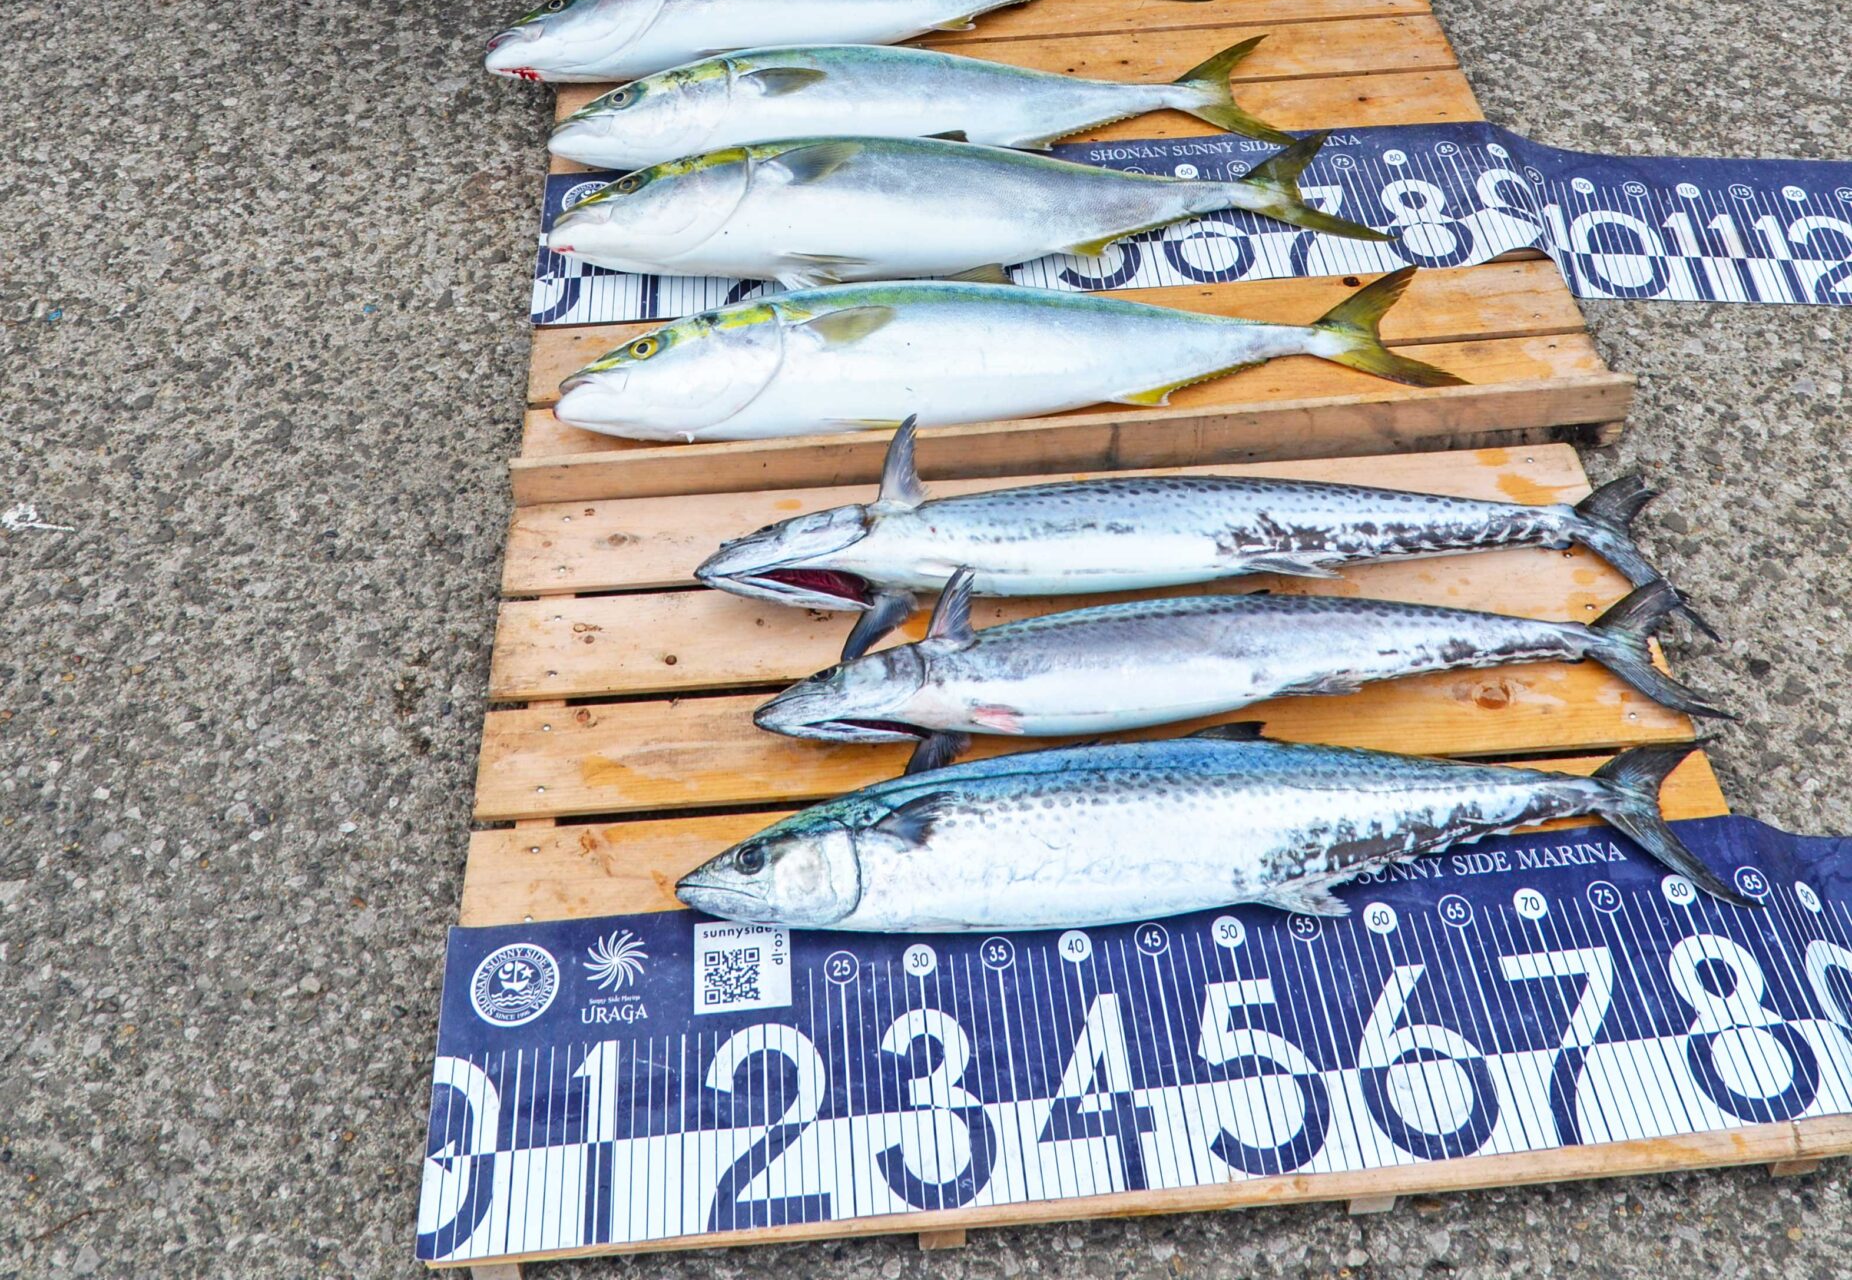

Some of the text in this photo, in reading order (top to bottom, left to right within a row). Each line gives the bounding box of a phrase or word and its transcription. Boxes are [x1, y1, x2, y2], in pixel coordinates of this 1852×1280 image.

[1090, 145, 1168, 162] SHONAN
[1173, 141, 1235, 158] SUNNY
[1238, 139, 1282, 153] SIDE
[1179, 166, 1194, 177] 60
[1232, 163, 1245, 174] 65
[1335, 157, 1351, 167] 75
[1388, 152, 1402, 163] 80
[1439, 144, 1454, 153] 85
[1574, 180, 1592, 191] 100
[1625, 185, 1644, 194] 105
[1679, 186, 1698, 196] 110
[1731, 187, 1750, 197] 115
[1784, 189, 1803, 199] 120
[1381, 178, 1475, 269] 8
[1661, 211, 1764, 303] 11
[1451, 851, 1512, 877] SIDE
[1516, 841, 1627, 871] MARINA
[832, 873, 1816, 976] 25 30 35 40 45 50 55 60 65 70 75 80 85 90
[475, 947, 555, 1017] SHONAN SUNNY SIDE MARINA
[494, 1011, 516, 1020] SINCE
[580, 1003, 649, 1024] URAGA
[572, 1039, 618, 1247] 1
[705, 1022, 832, 1234] 2
[875, 1007, 999, 1212] 3
[1039, 992, 1158, 1192] 4
[1196, 977, 1331, 1177] 5
[1358, 963, 1501, 1162] 6
[1497, 945, 1616, 1147] 7
[1668, 933, 1821, 1126] 8
